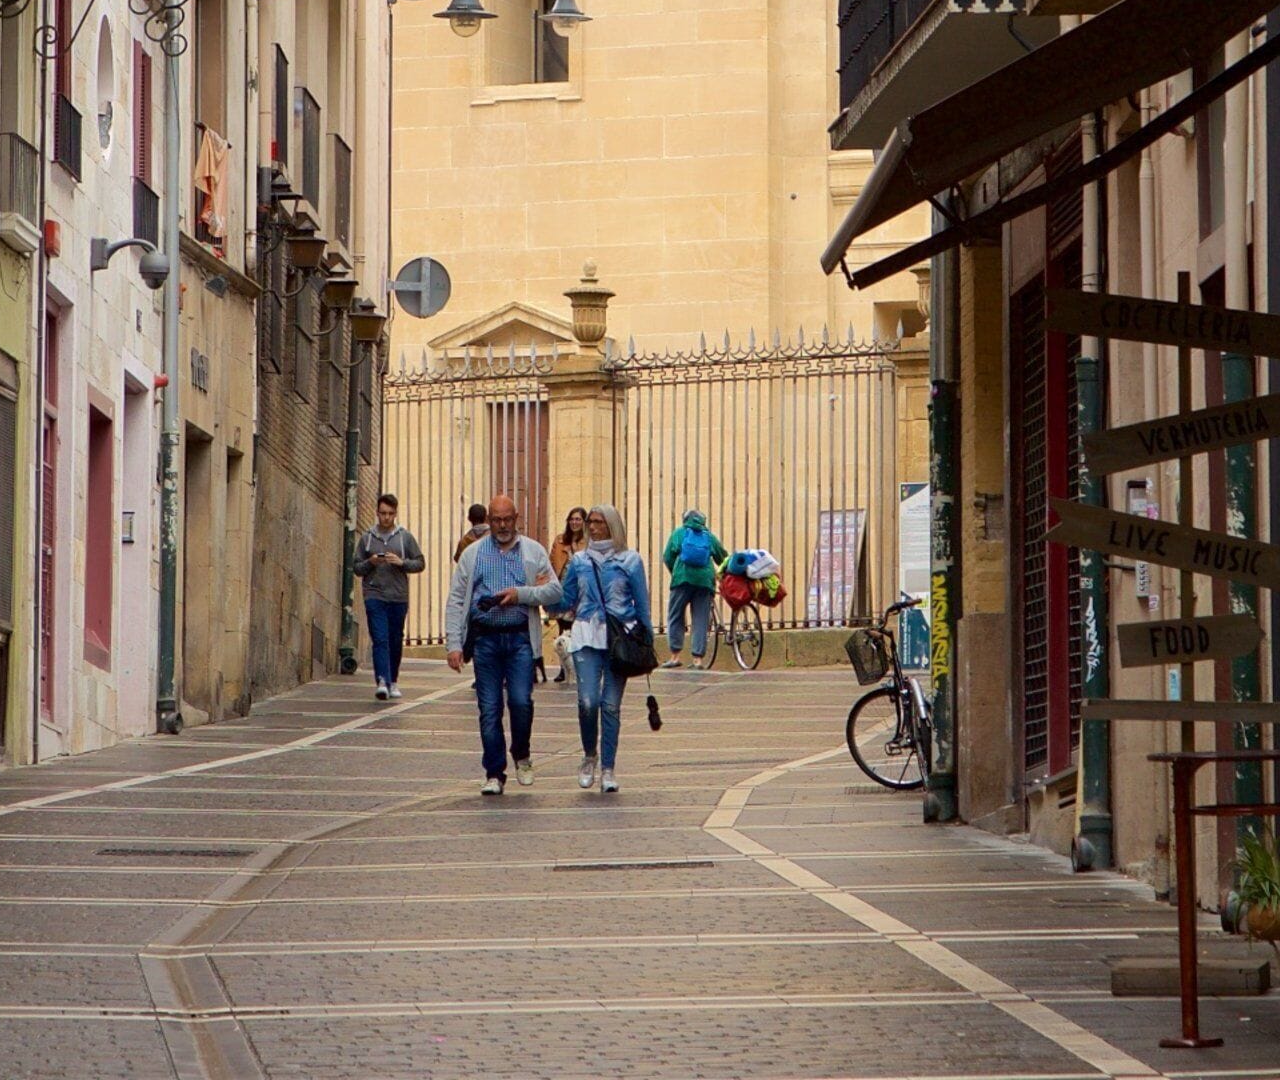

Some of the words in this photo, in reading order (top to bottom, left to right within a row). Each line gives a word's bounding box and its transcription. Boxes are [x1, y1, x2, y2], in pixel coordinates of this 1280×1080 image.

[1107, 520, 1171, 557] LIVE
[1193, 539, 1262, 576] MUSIC
[1149, 624, 1210, 658] FOOD
